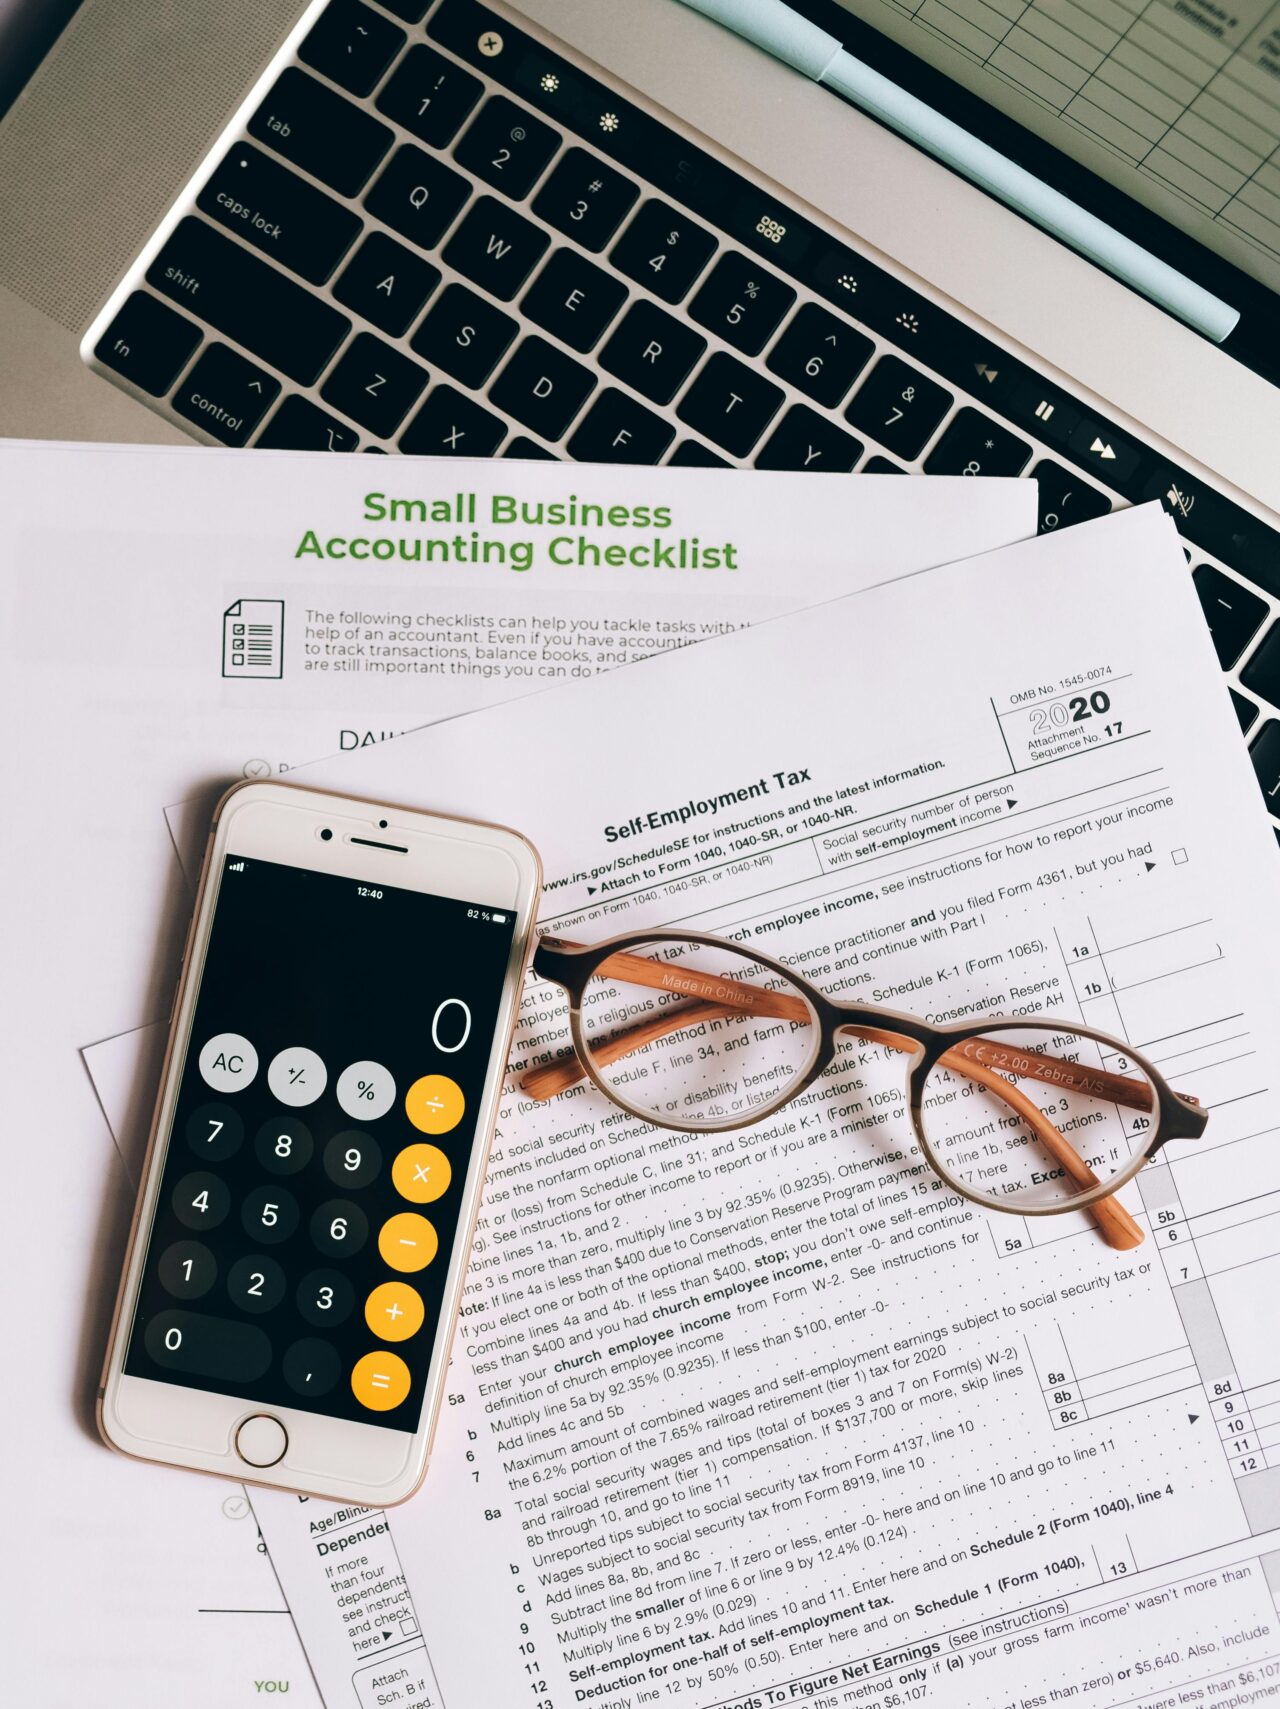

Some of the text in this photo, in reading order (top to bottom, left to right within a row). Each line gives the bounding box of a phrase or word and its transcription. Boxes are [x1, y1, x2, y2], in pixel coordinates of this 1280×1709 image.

[418, 98, 431, 116] 1
[267, 115, 291, 137] tab
[491, 148, 511, 170] 2
[409, 186, 429, 210] Q
[216, 192, 281, 239] caps lock
[569, 200, 588, 221] 3
[486, 234, 512, 260] W
[648, 254, 666, 272] 4
[165, 267, 200, 294] shift
[376, 275, 395, 297] A
[565, 289, 585, 311] E
[726, 303, 746, 324] 5
[114, 339, 130, 357] fn
[456, 326, 476, 347] S
[642, 340, 663, 364] R
[805, 356, 824, 377] 6
[365, 373, 387, 397] Z
[532, 376, 553, 398] D
[190, 393, 243, 431] control
[725, 392, 743, 413] T
[885, 407, 904, 426] 7
[442, 425, 465, 449] X
[612, 429, 632, 447] F
[804, 445, 822, 467] Y
[363, 492, 672, 529] Small Business
[294, 530, 738, 572] Accounting Checklist
[305, 609, 335, 624] The
[339, 610, 412, 629] following
[416, 613, 495, 628] checklists
[498, 617, 527, 628] can
[532, 616, 566, 633] help
[570, 620, 599, 634] you
[603, 618, 651, 632] tackle
[655, 620, 696, 633] tasks
[699, 621, 736, 635] with
[305, 626, 614, 649] help of an accountant. Even if you have
[304, 643, 321, 655] to
[324, 643, 365, 656] track
[369, 644, 471, 661] transactions,
[475, 646, 537, 661] balance
[542, 648, 592, 664] books,
[596, 650, 627, 663] and
[304, 658, 592, 679] are still important things you can do
[1009, 665, 1112, 705] OMB No. 1545-0074
[1028, 689, 1112, 736] 2020
[1028, 725, 1085, 750] Attachment
[1030, 721, 1123, 761] Sequence No. 17
[604, 768, 812, 843] Self-Employment Tax
[692, 760, 946, 845] for instructions and the latest information.
[822, 784, 1014, 850] Social security number of person
[828, 805, 1002, 865] with self-employment income
[600, 805, 858, 893] Attach to Form 1040, 1040-SR, or 1040-NR.
[357, 886, 384, 900] 12:40
[467, 908, 490, 921] 82 %
[1072, 946, 1090, 958] 1a
[662, 974, 754, 1004] Made in China
[1084, 982, 1102, 996] 1b
[431, 998, 472, 1053] 0
[212, 1052, 244, 1074] AC
[991, 1052, 1029, 1072] +2.00
[1034, 1063, 1074, 1085] Zebra
[357, 1080, 375, 1101] %
[207, 1120, 224, 1142] 7
[274, 1134, 292, 1158] 8
[343, 1148, 362, 1171] 9
[191, 1190, 209, 1213] 4
[261, 1203, 279, 1227] 5
[330, 1217, 348, 1241] 6
[1004, 1239, 1023, 1251] 5a
[182, 1259, 193, 1282] 1
[247, 1272, 265, 1296] 2
[316, 1286, 334, 1310] 3
[165, 1327, 182, 1351] 0
[1047, 1372, 1066, 1385] 8a
[1053, 1390, 1072, 1404] 8b
[465, 1405, 625, 1462] 6 Add lines 4c and 5b
[324, 1556, 369, 1579] If more
[330, 1566, 384, 1593] than four
[342, 1608, 364, 1623] see
[348, 1606, 411, 1638] and check
[352, 1635, 381, 1652] here
[524, 1593, 757, 1675] 11 Multiply line 6 by 2.9% (0.029)
[574, 1596, 894, 1702] Deduction for one-half of self-employment tax.
[254, 1680, 290, 1693] YOU
[372, 1668, 409, 1690] Attach
[376, 1678, 425, 1706] Sch. B if
